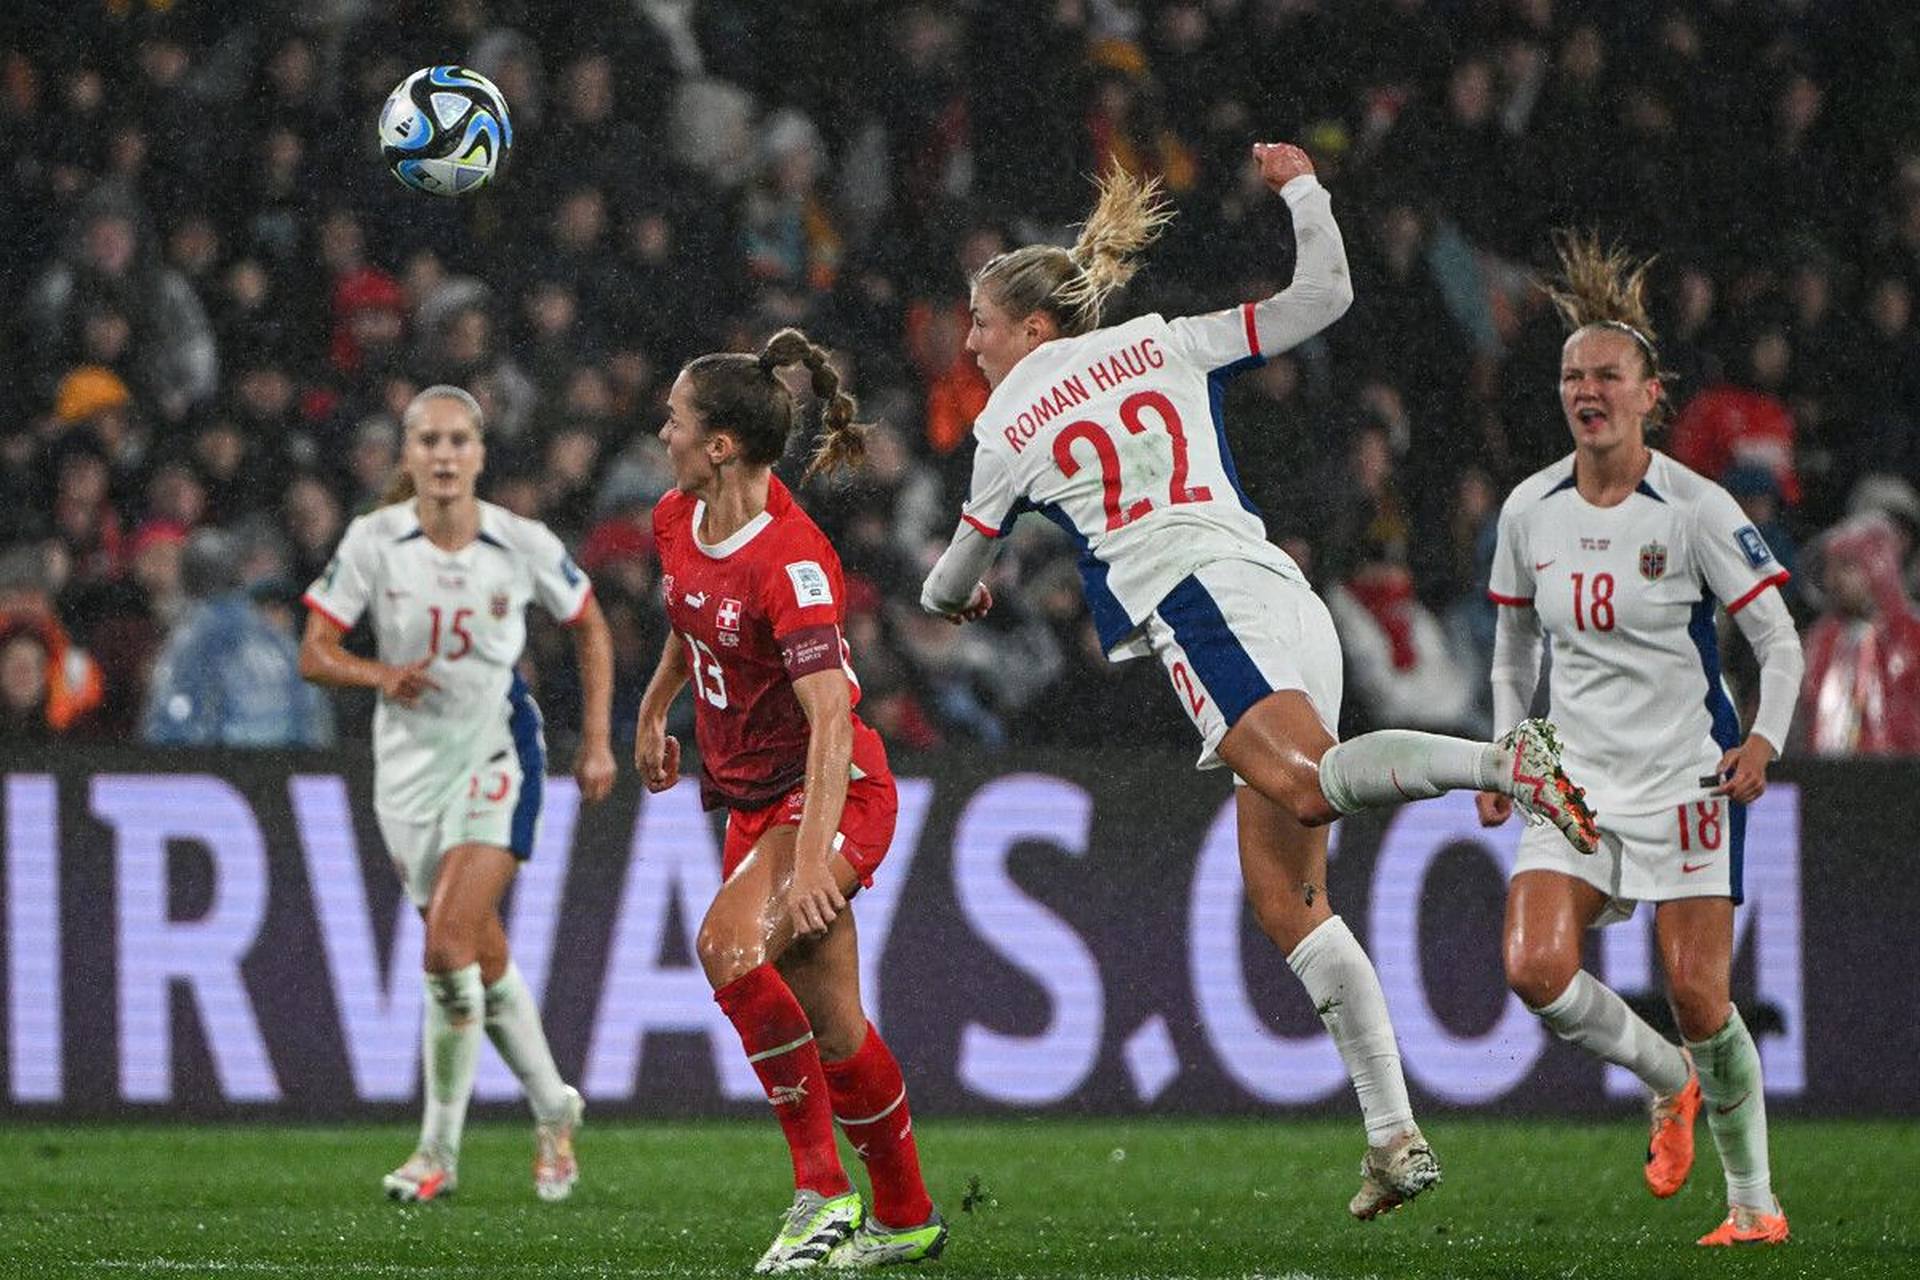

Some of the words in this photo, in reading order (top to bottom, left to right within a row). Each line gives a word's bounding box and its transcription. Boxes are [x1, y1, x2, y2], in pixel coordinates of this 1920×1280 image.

[1004, 375, 1090, 454] ROMAN
[1088, 338, 1165, 392] HAUG
[1052, 390, 1213, 532] 22
[428, 605, 475, 661] 15
[1571, 572, 1615, 632] 18
[684, 632, 728, 710] 13
[1677, 800, 1722, 851] 18
